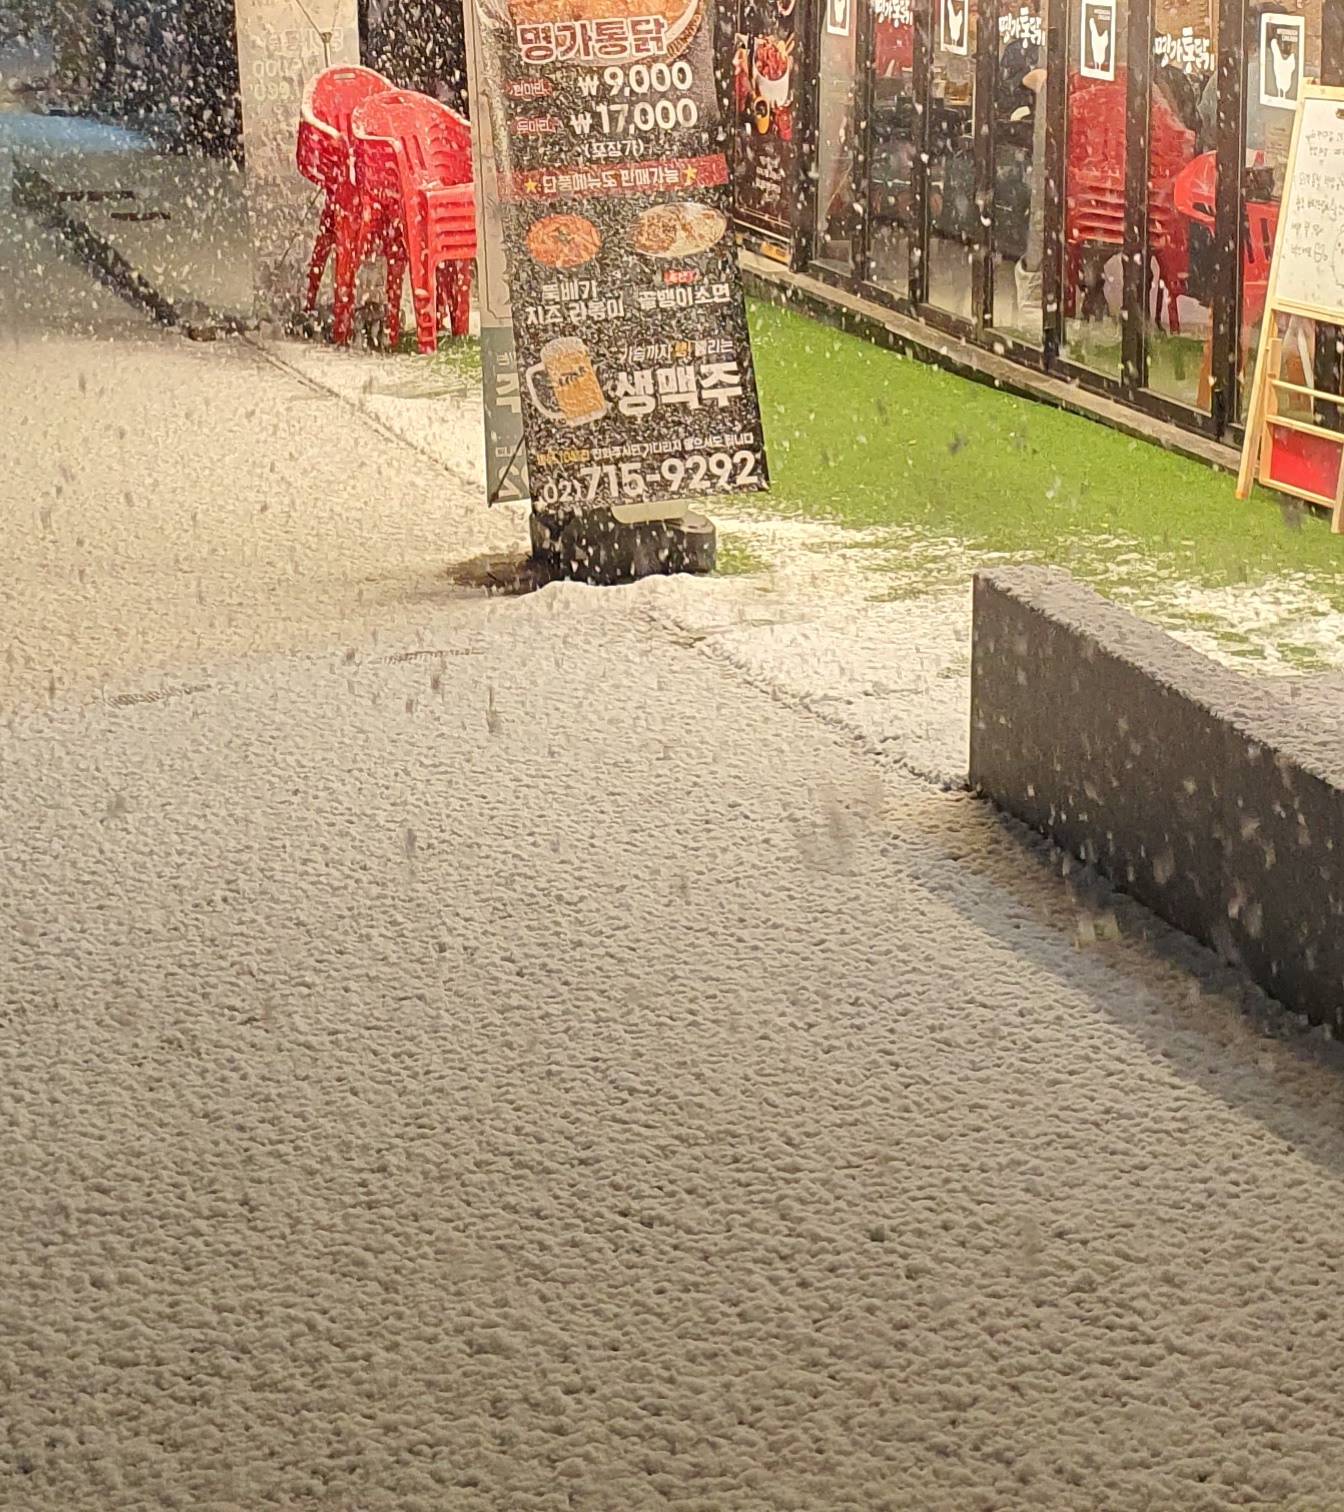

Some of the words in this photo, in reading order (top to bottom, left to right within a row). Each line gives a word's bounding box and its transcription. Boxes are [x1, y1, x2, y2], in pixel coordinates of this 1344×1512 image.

[517, 15, 667, 64] 명가통닭
[1154, 26, 1211, 74] 명가통닭
[620, 166, 680, 187] 판매가능
[527, 303, 563, 326] 치즈
[613, 360, 743, 416] 생맥주
